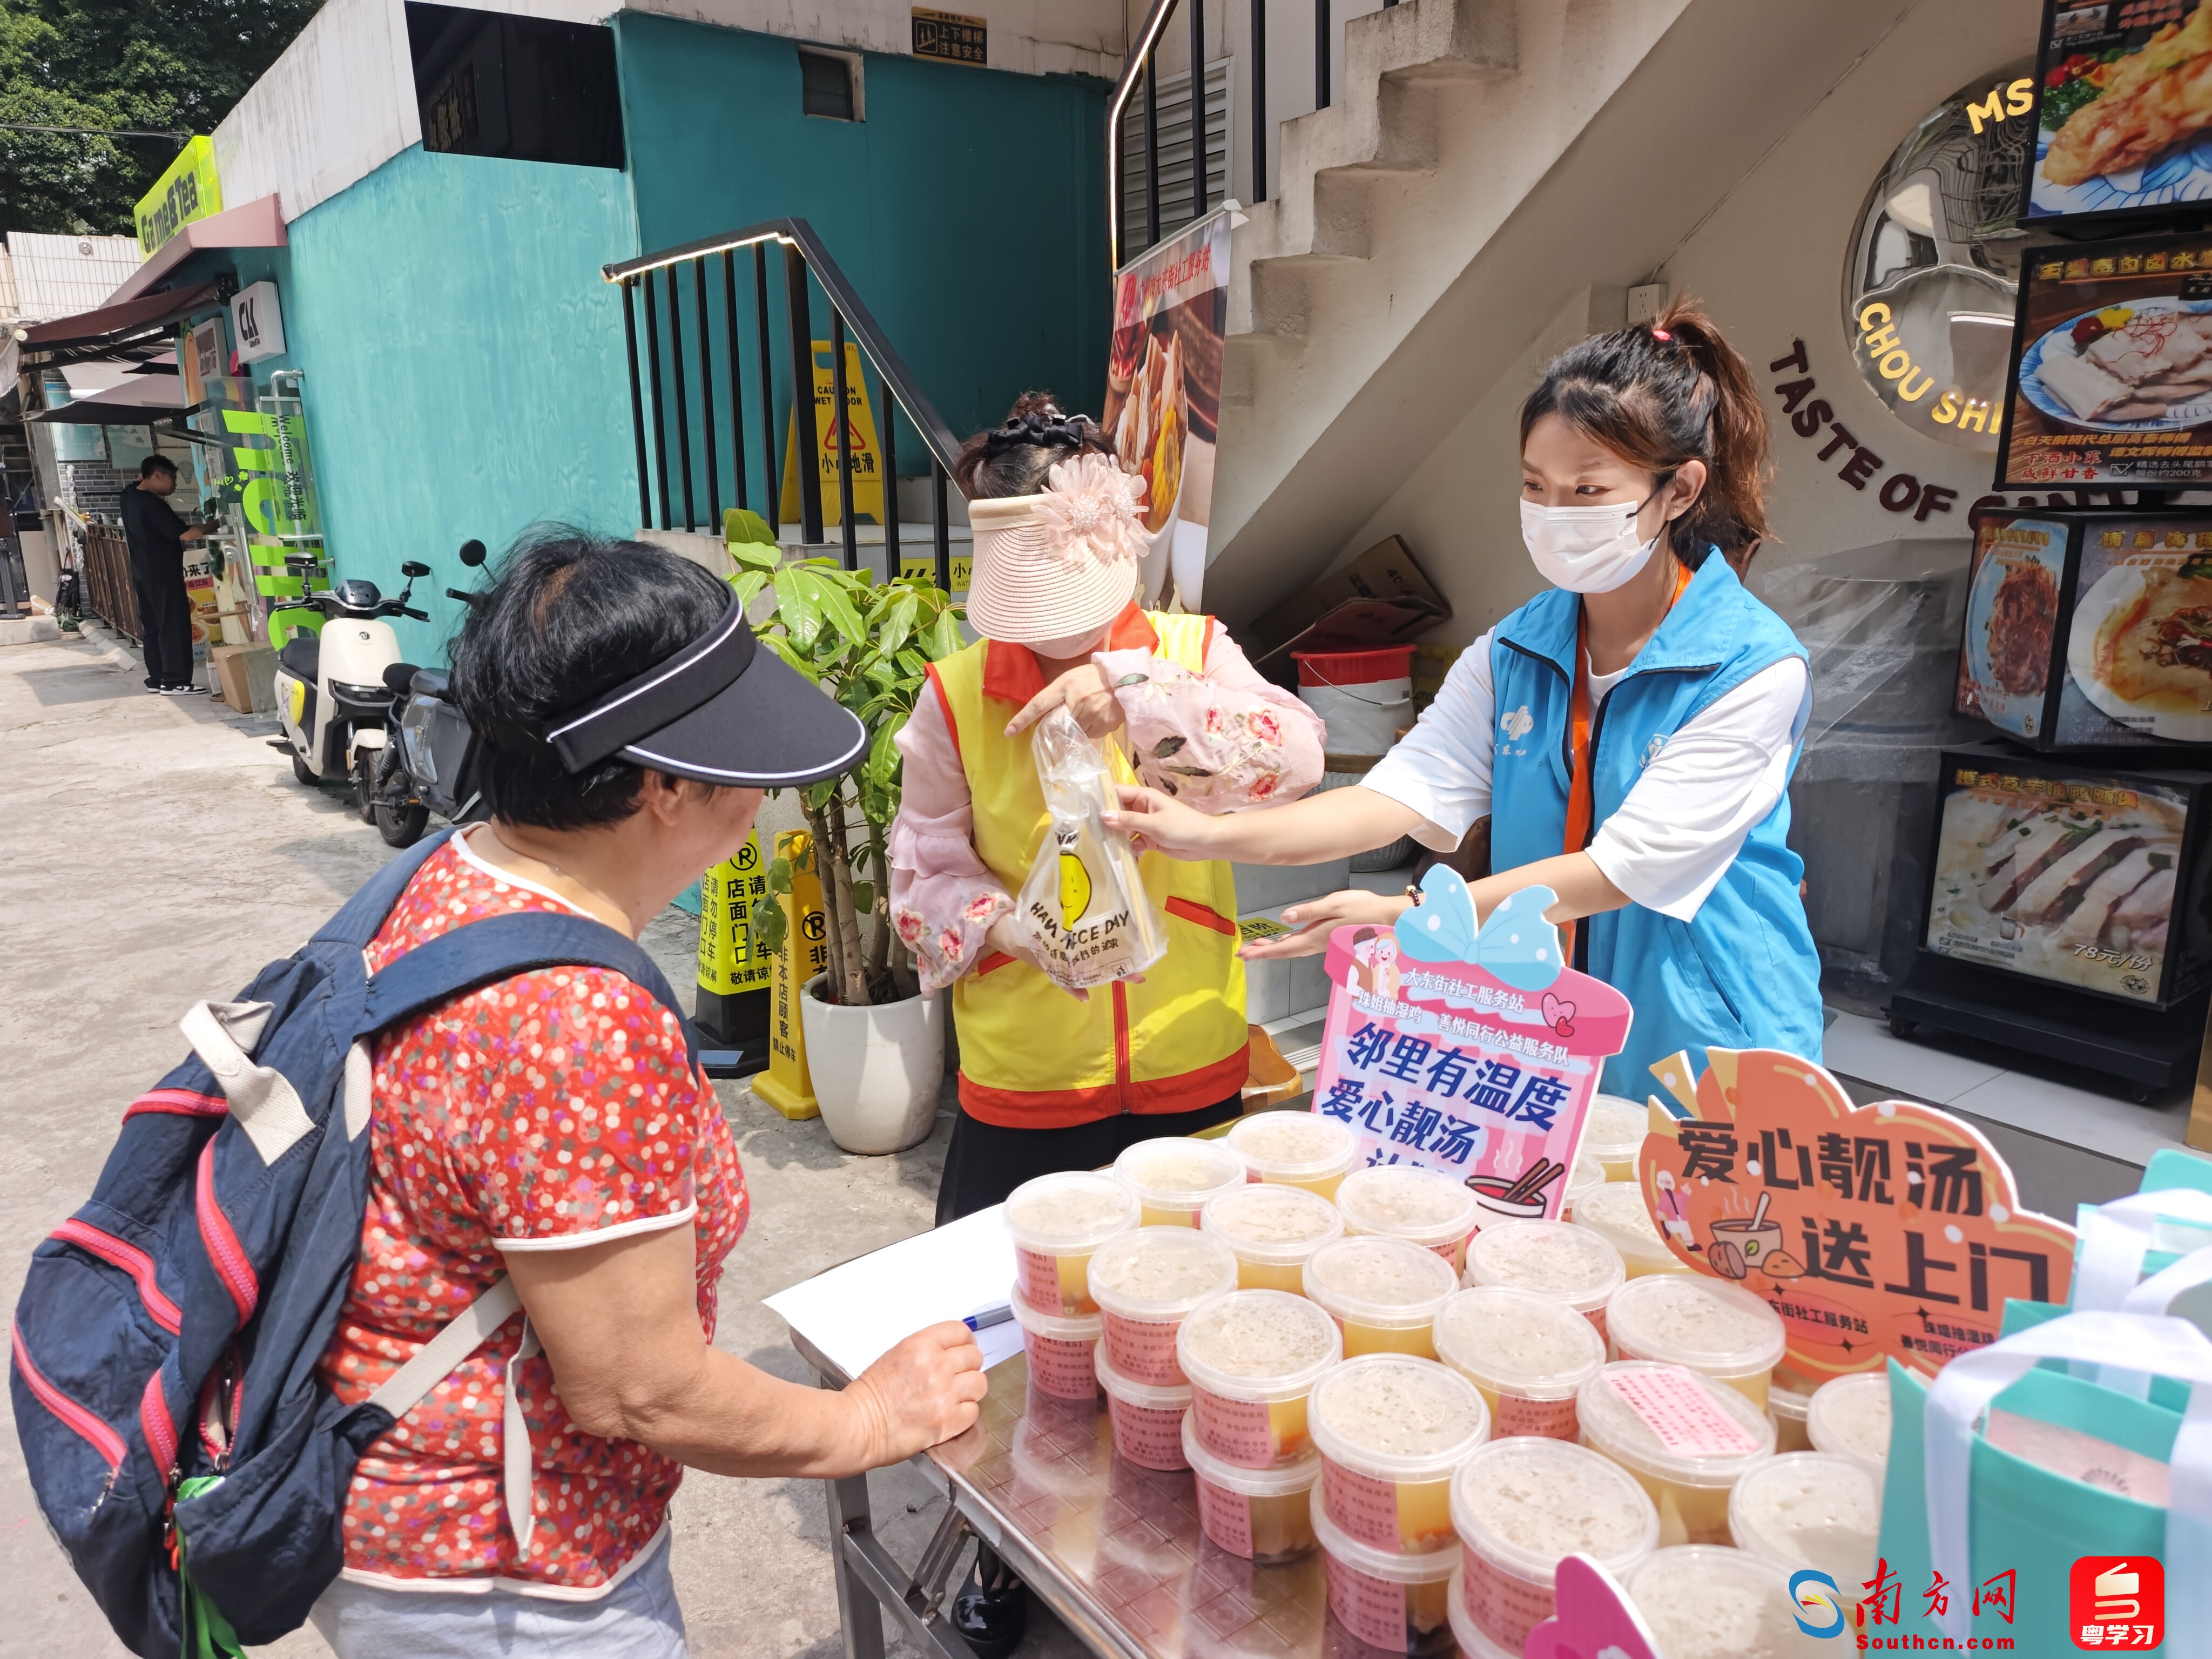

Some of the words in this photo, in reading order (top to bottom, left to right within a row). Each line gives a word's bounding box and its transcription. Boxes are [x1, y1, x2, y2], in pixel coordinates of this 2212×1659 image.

[939, 25, 984, 44] 上下楼梯
[939, 41, 984, 61] 注意安全
[141, 171, 199, 254] Game&Tea
[1859, 302, 1934, 403] CHOU
[814, 397, 832, 406] WET
[817, 386, 857, 395] CAUON
[279, 414, 294, 464] Welcome
[1769, 337, 1884, 492] TASTE
[1878, 473, 1959, 522] OF
[822, 453, 874, 474] 小地滑
[2020, 467, 2099, 481] 咸鲜甘香
[2023, 450, 2103, 466] 下酒小菜
[953, 562, 972, 578] 小
[707, 875, 719, 961] 请勿停车
[727, 878, 749, 965] 店面门口
[1105, 910, 1130, 935] DAY
[730, 965, 771, 986] 敬请谅
[2073, 943, 2154, 973] 78元/份
[778, 945, 788, 1040] 非本店顾客
[1405, 966, 1526, 1015] 大东街社工服务站
[773, 1036, 797, 1063] 禁止停车
[1357, 990, 1422, 1024] 珠姐抽湿鸡
[1437, 1012, 1570, 1067] 善悦同行公益服务队
[1348, 1021, 1572, 1133] 邻里有温度
[1321, 1077, 1480, 1165] 爱心靓汤
[1677, 1120, 1984, 1218] 爱心靓汤
[1801, 1215, 2049, 1312] 送上门
